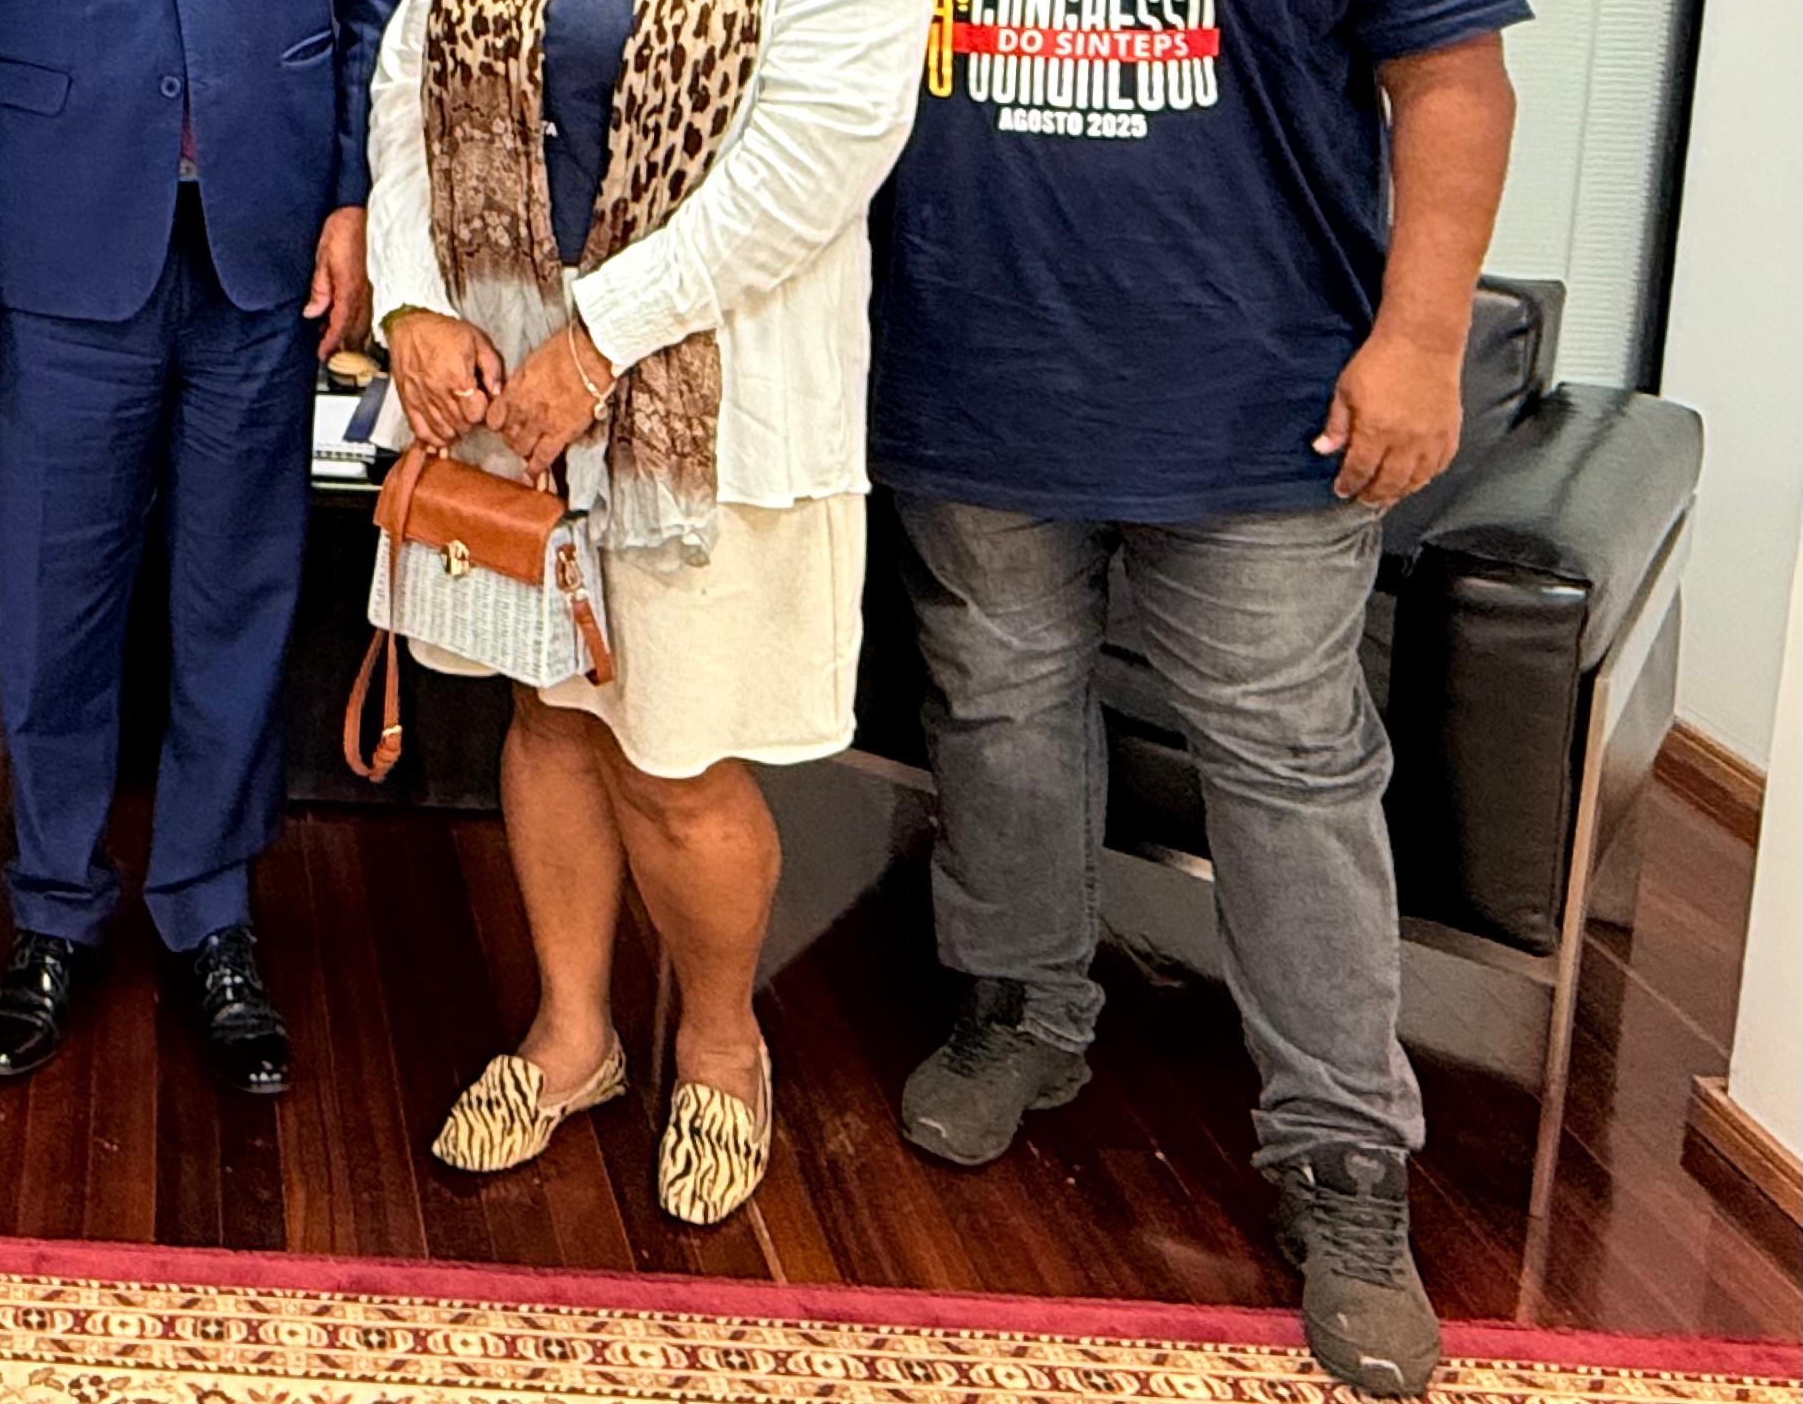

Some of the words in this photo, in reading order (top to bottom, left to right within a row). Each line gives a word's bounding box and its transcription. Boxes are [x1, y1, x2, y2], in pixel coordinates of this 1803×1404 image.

[999, 29, 1044, 53] DO
[1054, 31, 1190, 58] SINTEPS
[998, 107, 1084, 136] AGOSTO
[1086, 112, 1148, 138] 2025
